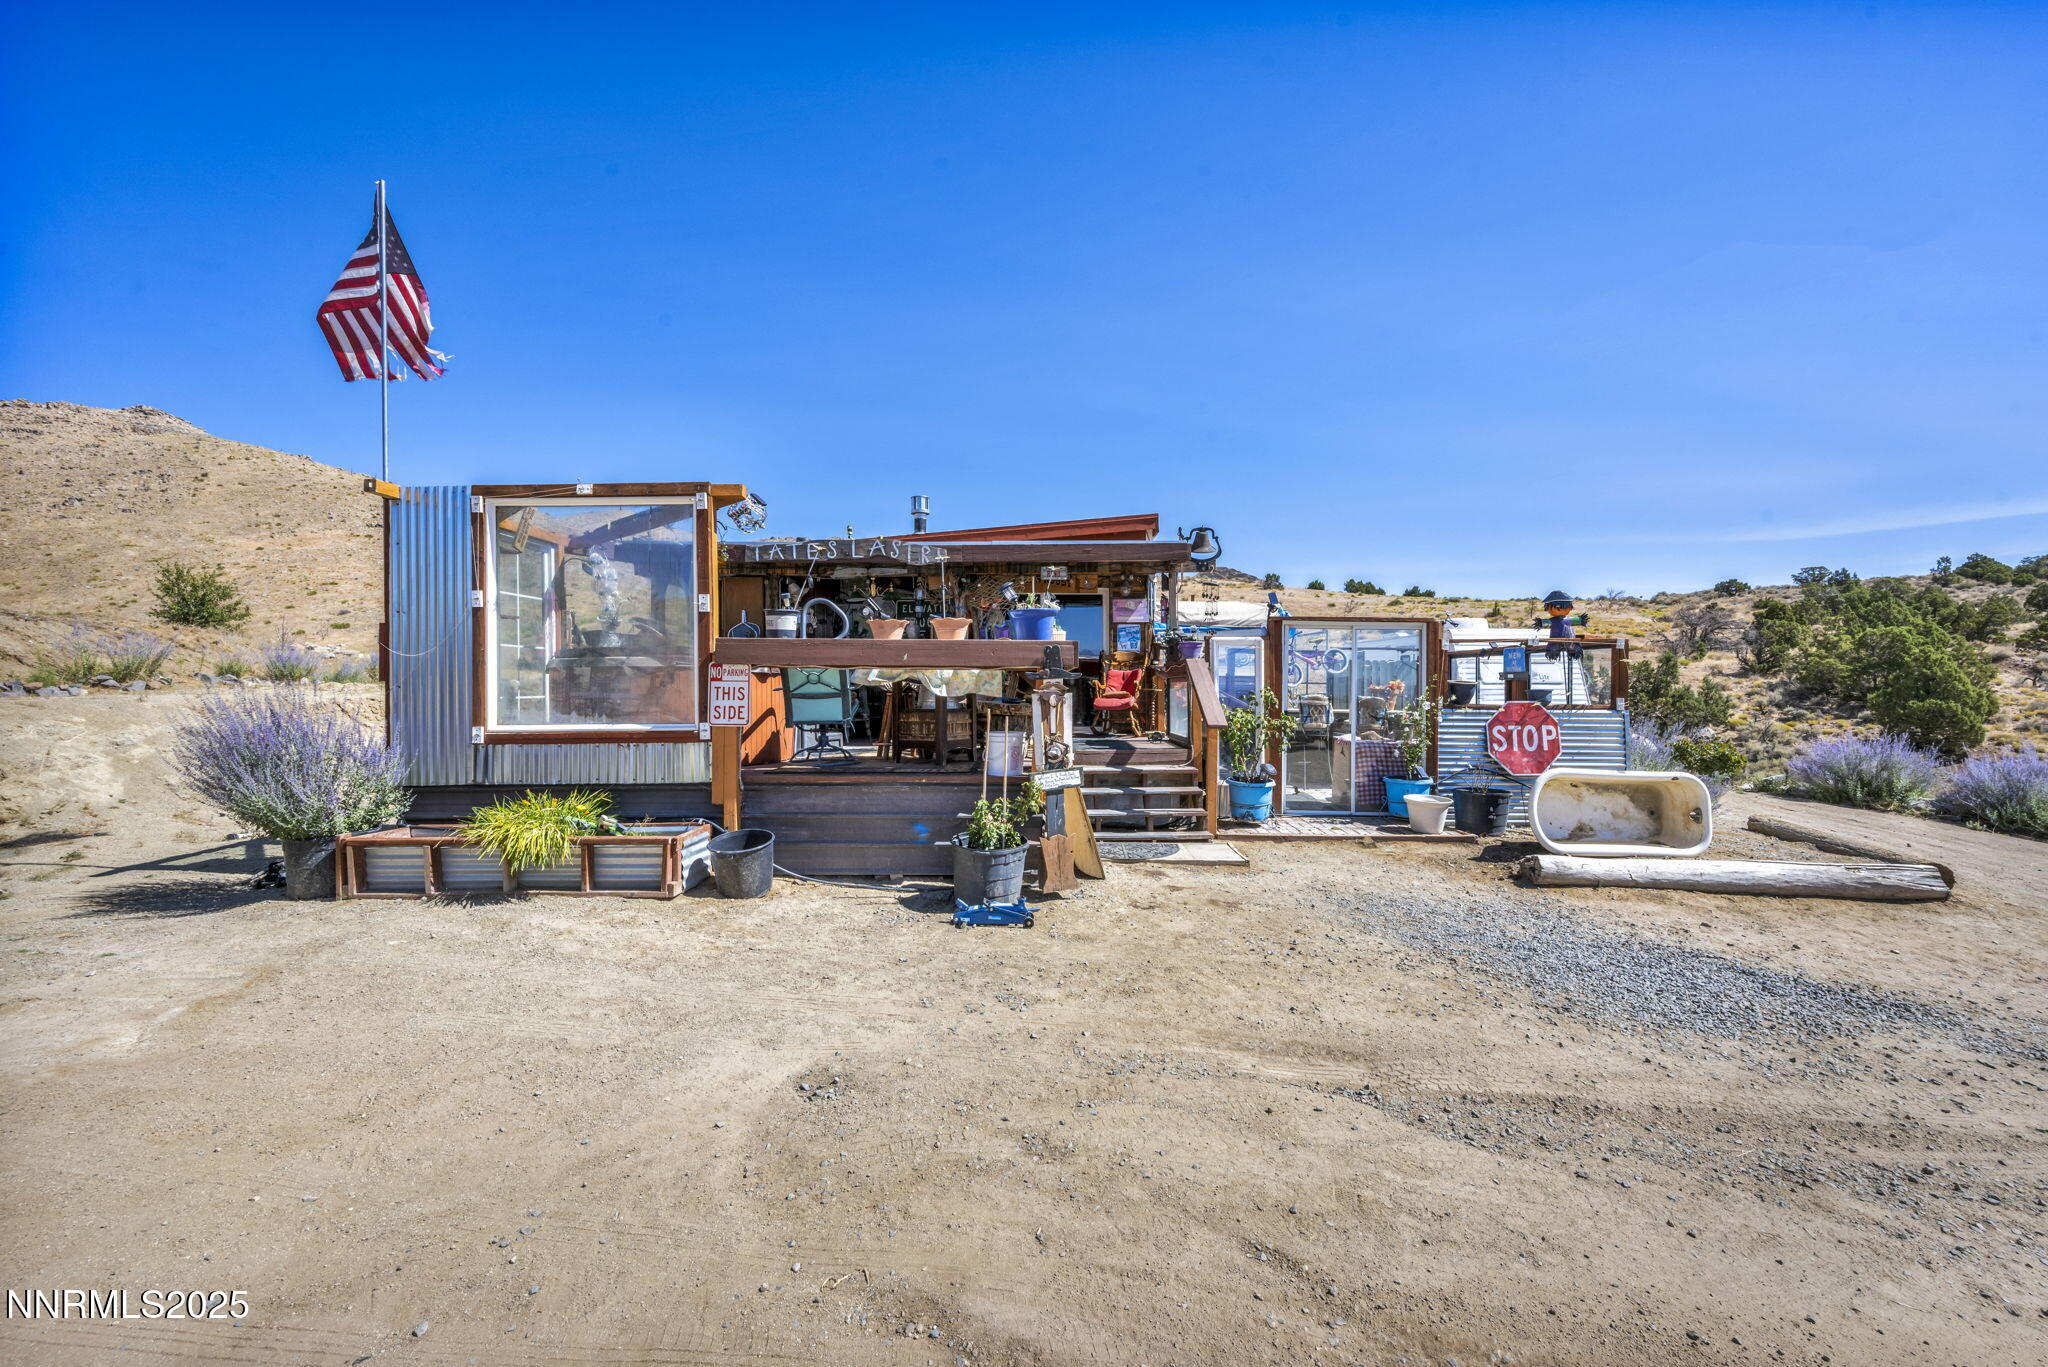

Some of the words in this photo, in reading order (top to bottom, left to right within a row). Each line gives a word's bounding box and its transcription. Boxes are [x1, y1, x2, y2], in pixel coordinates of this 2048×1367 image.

[851, 539, 914, 563] LAST
[902, 604, 956, 613] ELVATION
[711, 666, 722, 679] NO
[723, 669, 749, 677] PARKING
[714, 686, 745, 701] THIS
[714, 705, 745, 720] SIDE
[1492, 724, 1557, 752] STOP
